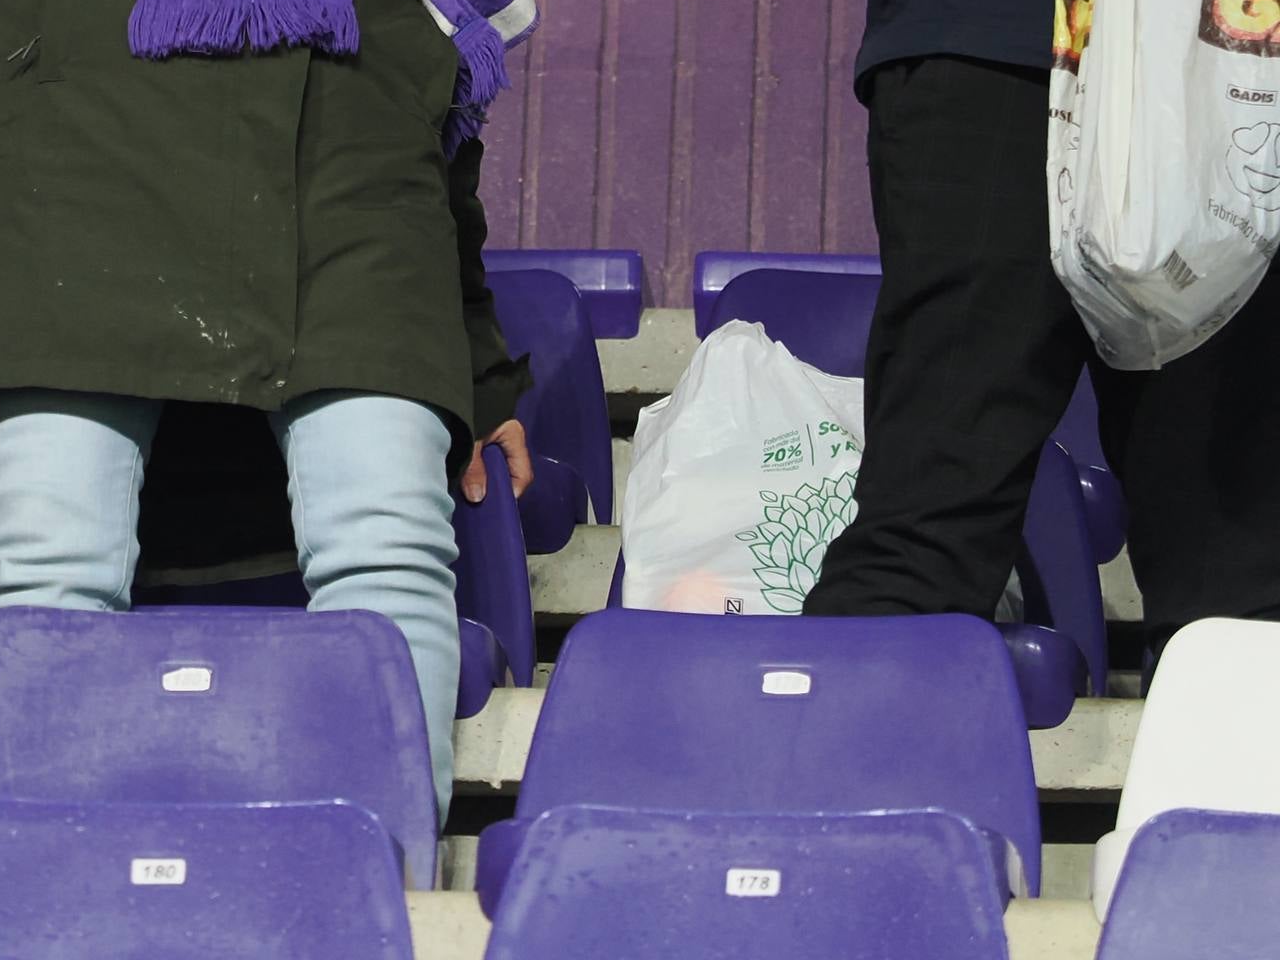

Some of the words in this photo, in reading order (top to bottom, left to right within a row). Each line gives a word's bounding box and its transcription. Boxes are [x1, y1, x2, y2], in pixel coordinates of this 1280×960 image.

[1228, 88, 1275, 104] GADIS
[763, 443, 802, 463] 70%
[143, 864, 177, 880] 180
[736, 875, 770, 890] 178
